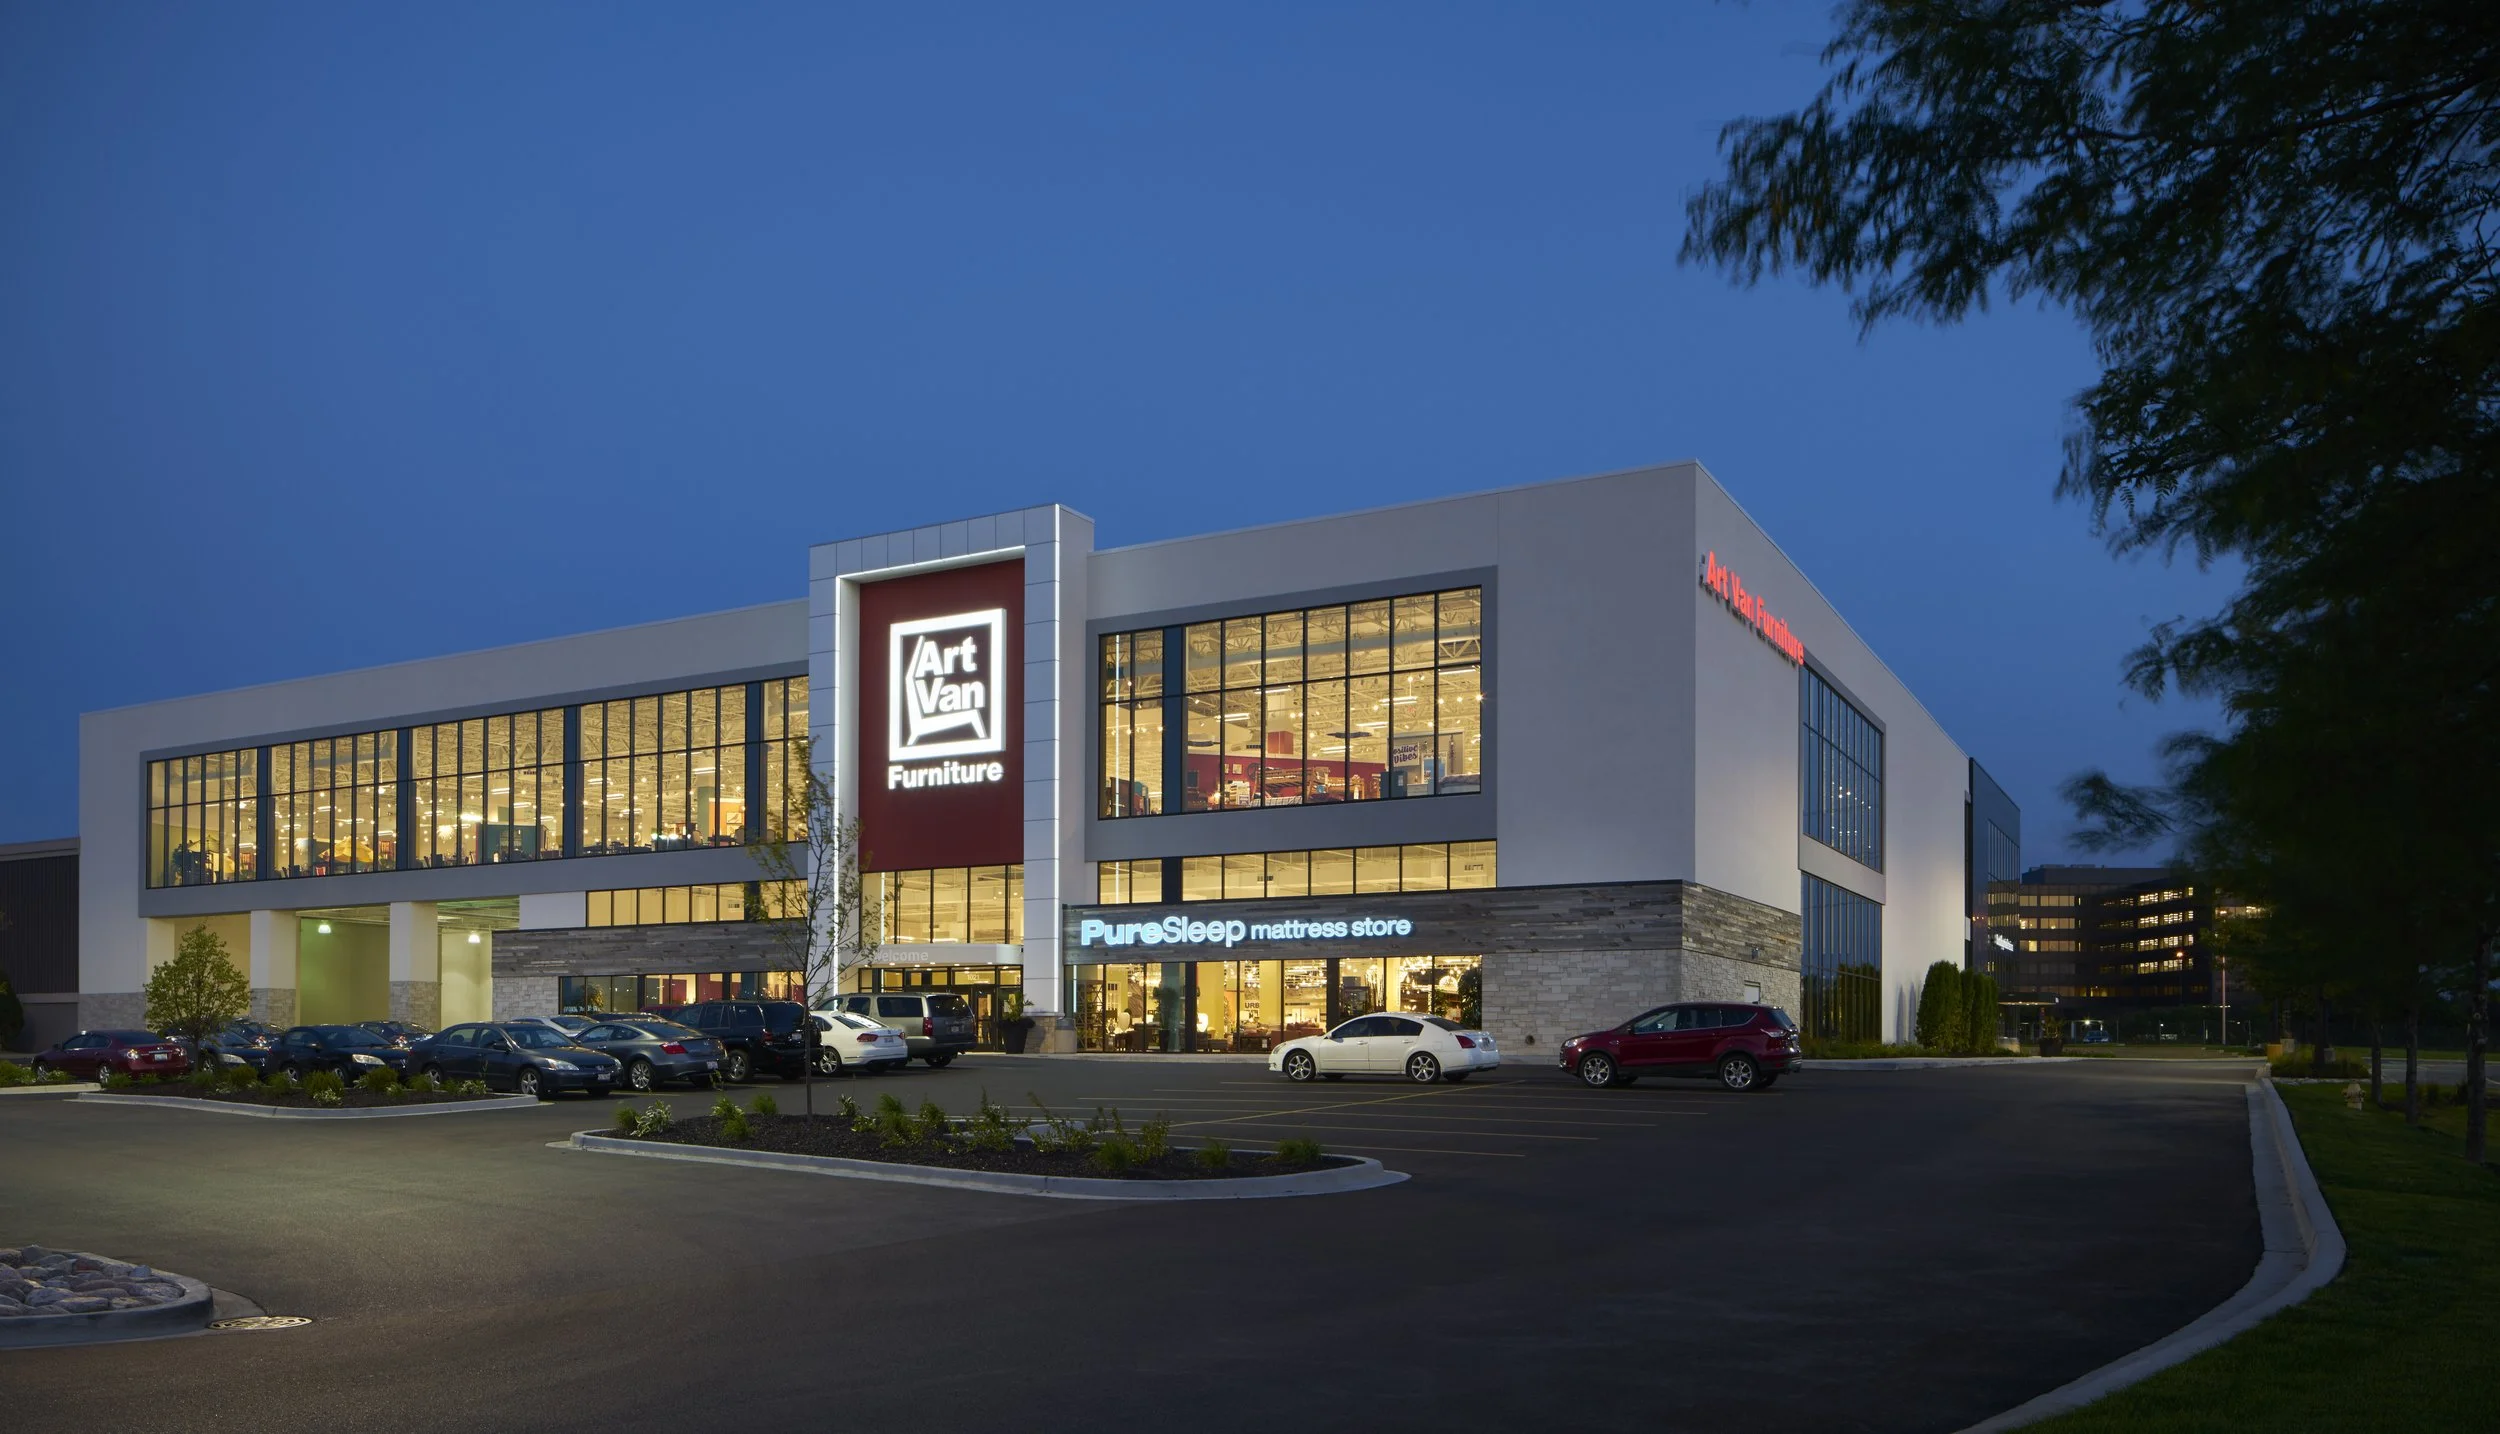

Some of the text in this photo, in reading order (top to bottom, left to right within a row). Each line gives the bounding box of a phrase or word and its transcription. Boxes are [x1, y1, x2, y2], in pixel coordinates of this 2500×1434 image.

[1707, 550, 1804, 665] Art Van Furniture
[914, 636, 977, 678] Art
[914, 677, 985, 714] Van
[1393, 744, 1418, 755] ositive
[888, 761, 1004, 790] Furniture
[1081, 915, 1412, 948] PureSleep mattress store
